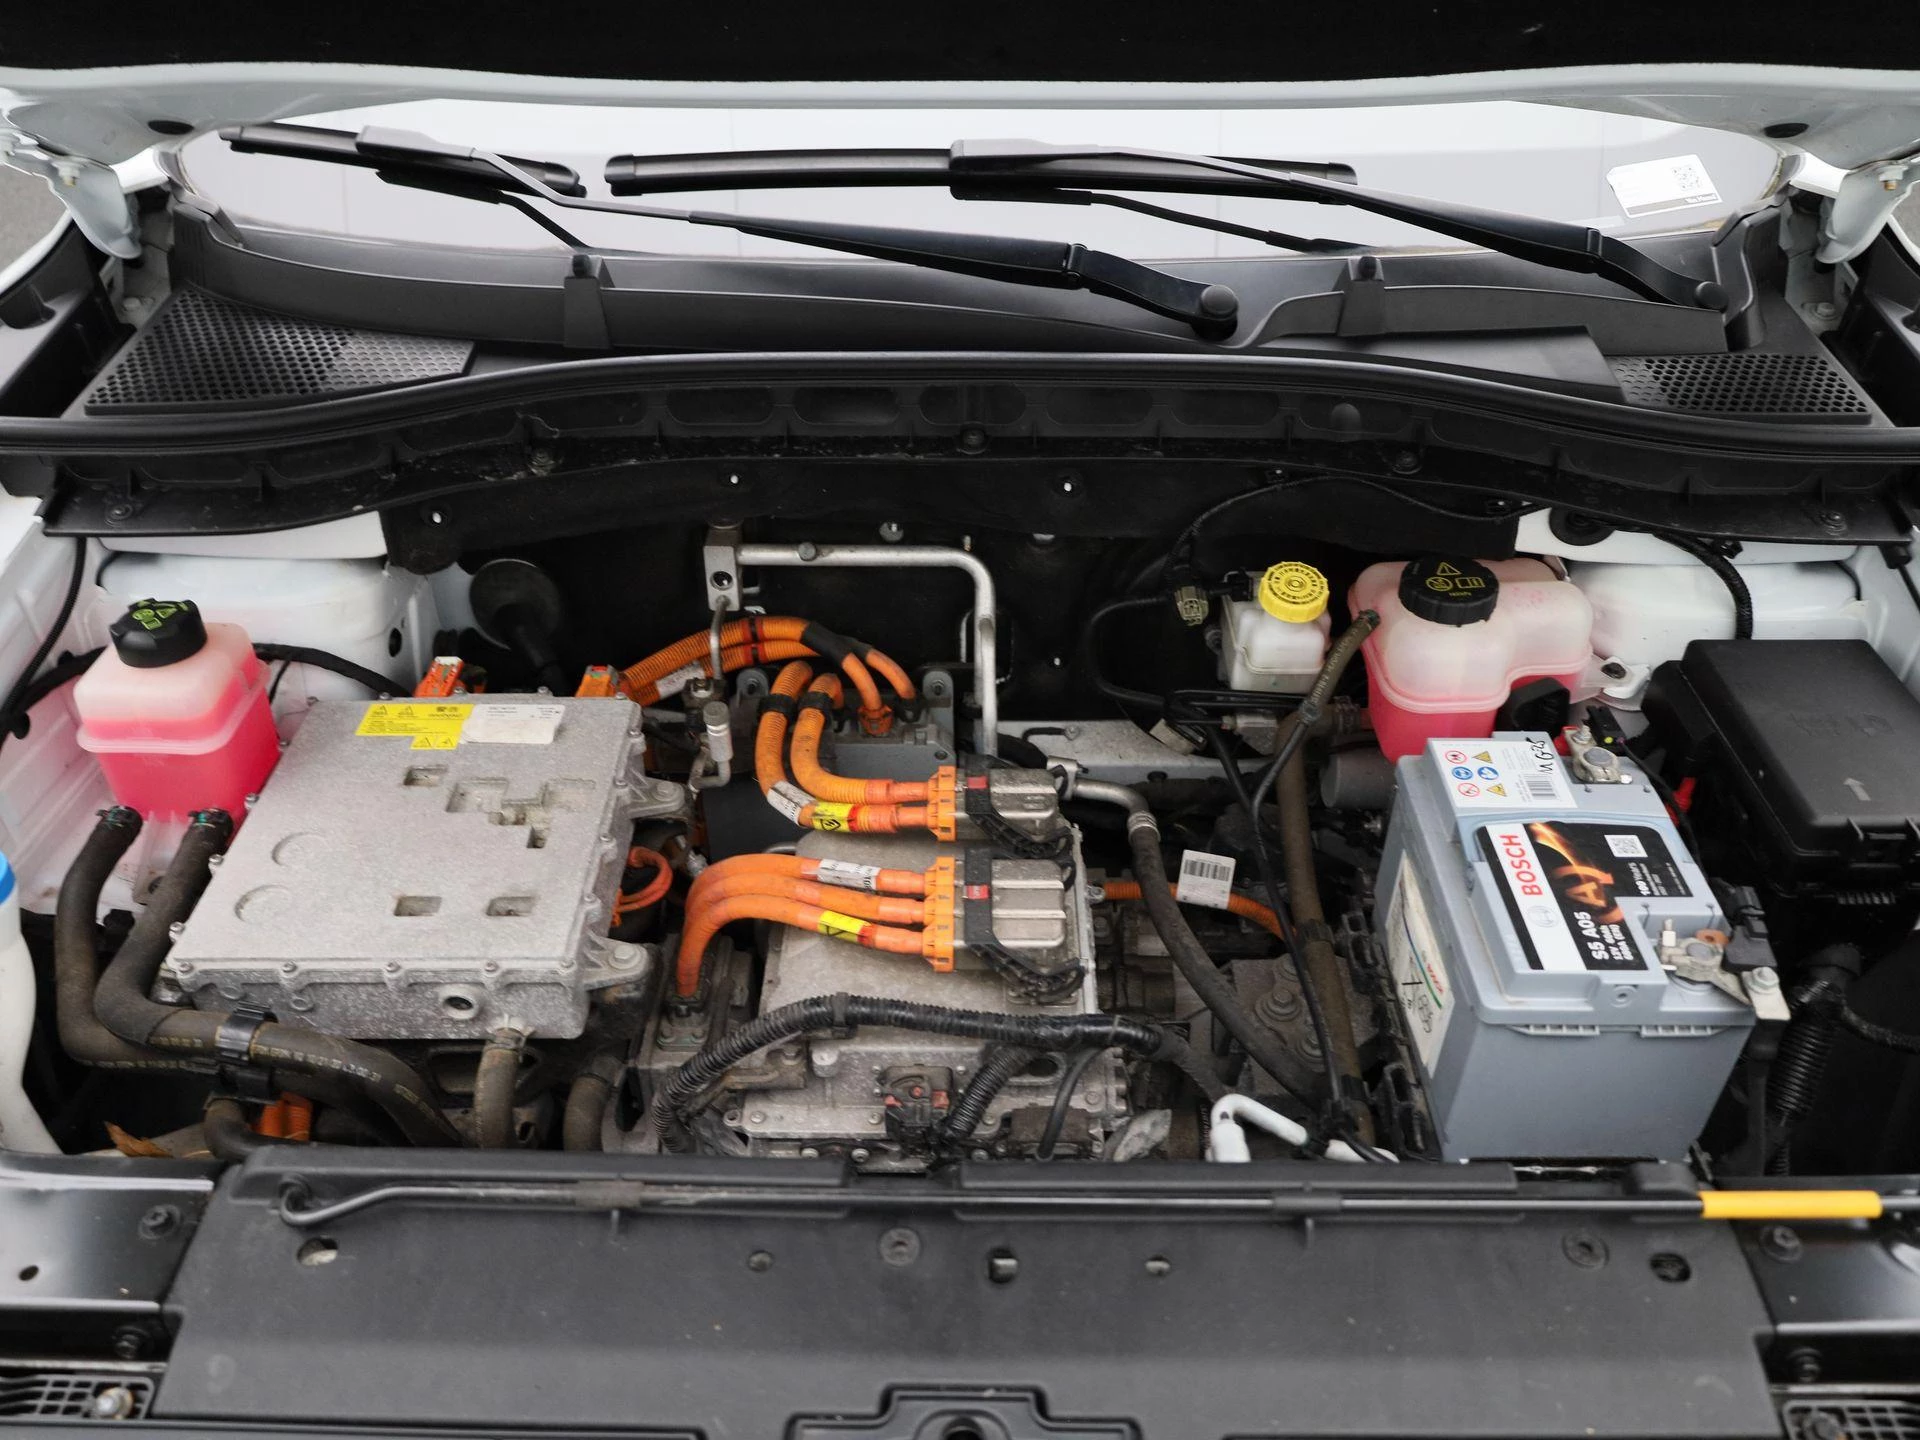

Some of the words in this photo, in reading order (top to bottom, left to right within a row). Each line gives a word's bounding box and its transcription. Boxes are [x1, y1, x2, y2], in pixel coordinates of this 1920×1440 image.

[1499, 834, 1543, 896] BOSCH
[1573, 911, 1601, 939] A05
[1587, 941, 1610, 960] S5
